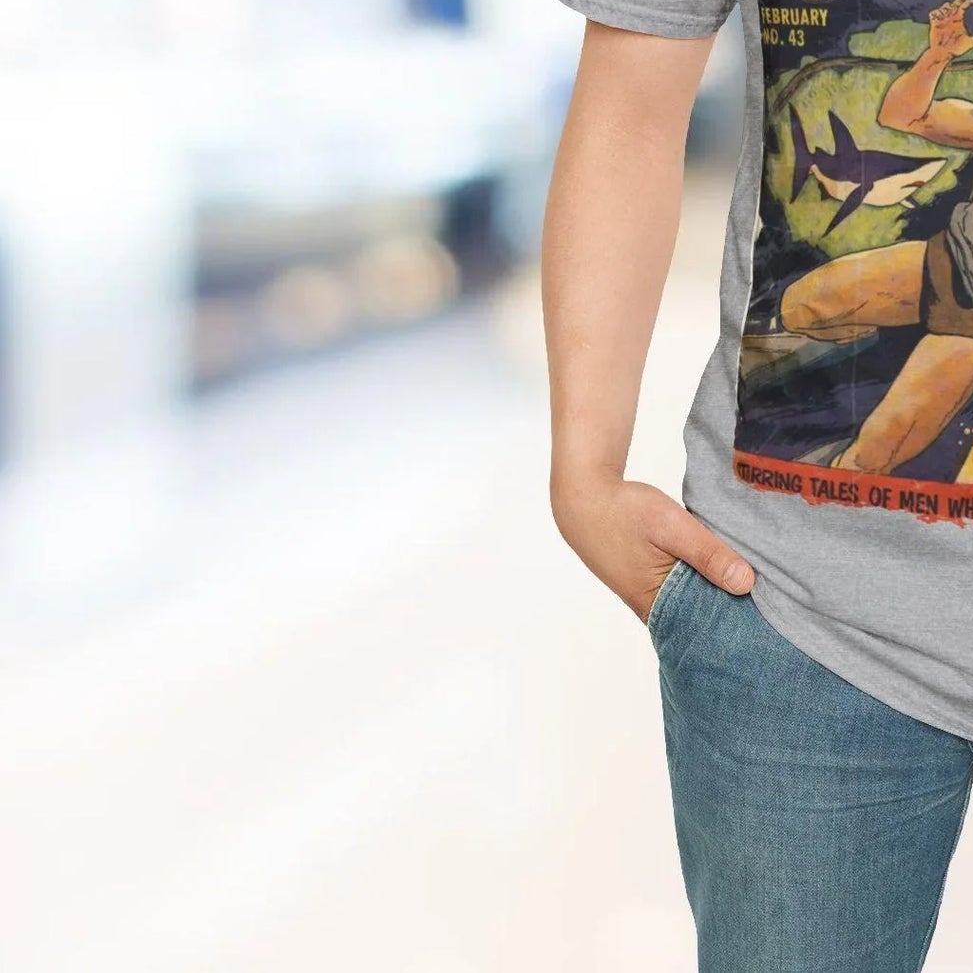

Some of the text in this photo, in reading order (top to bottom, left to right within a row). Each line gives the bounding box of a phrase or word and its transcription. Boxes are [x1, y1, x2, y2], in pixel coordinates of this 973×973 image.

[788, 29, 805, 47] 43
[810, 477, 859, 504] TALES
[869, 487, 892, 507] OF
[900, 490, 939, 515] MEN
